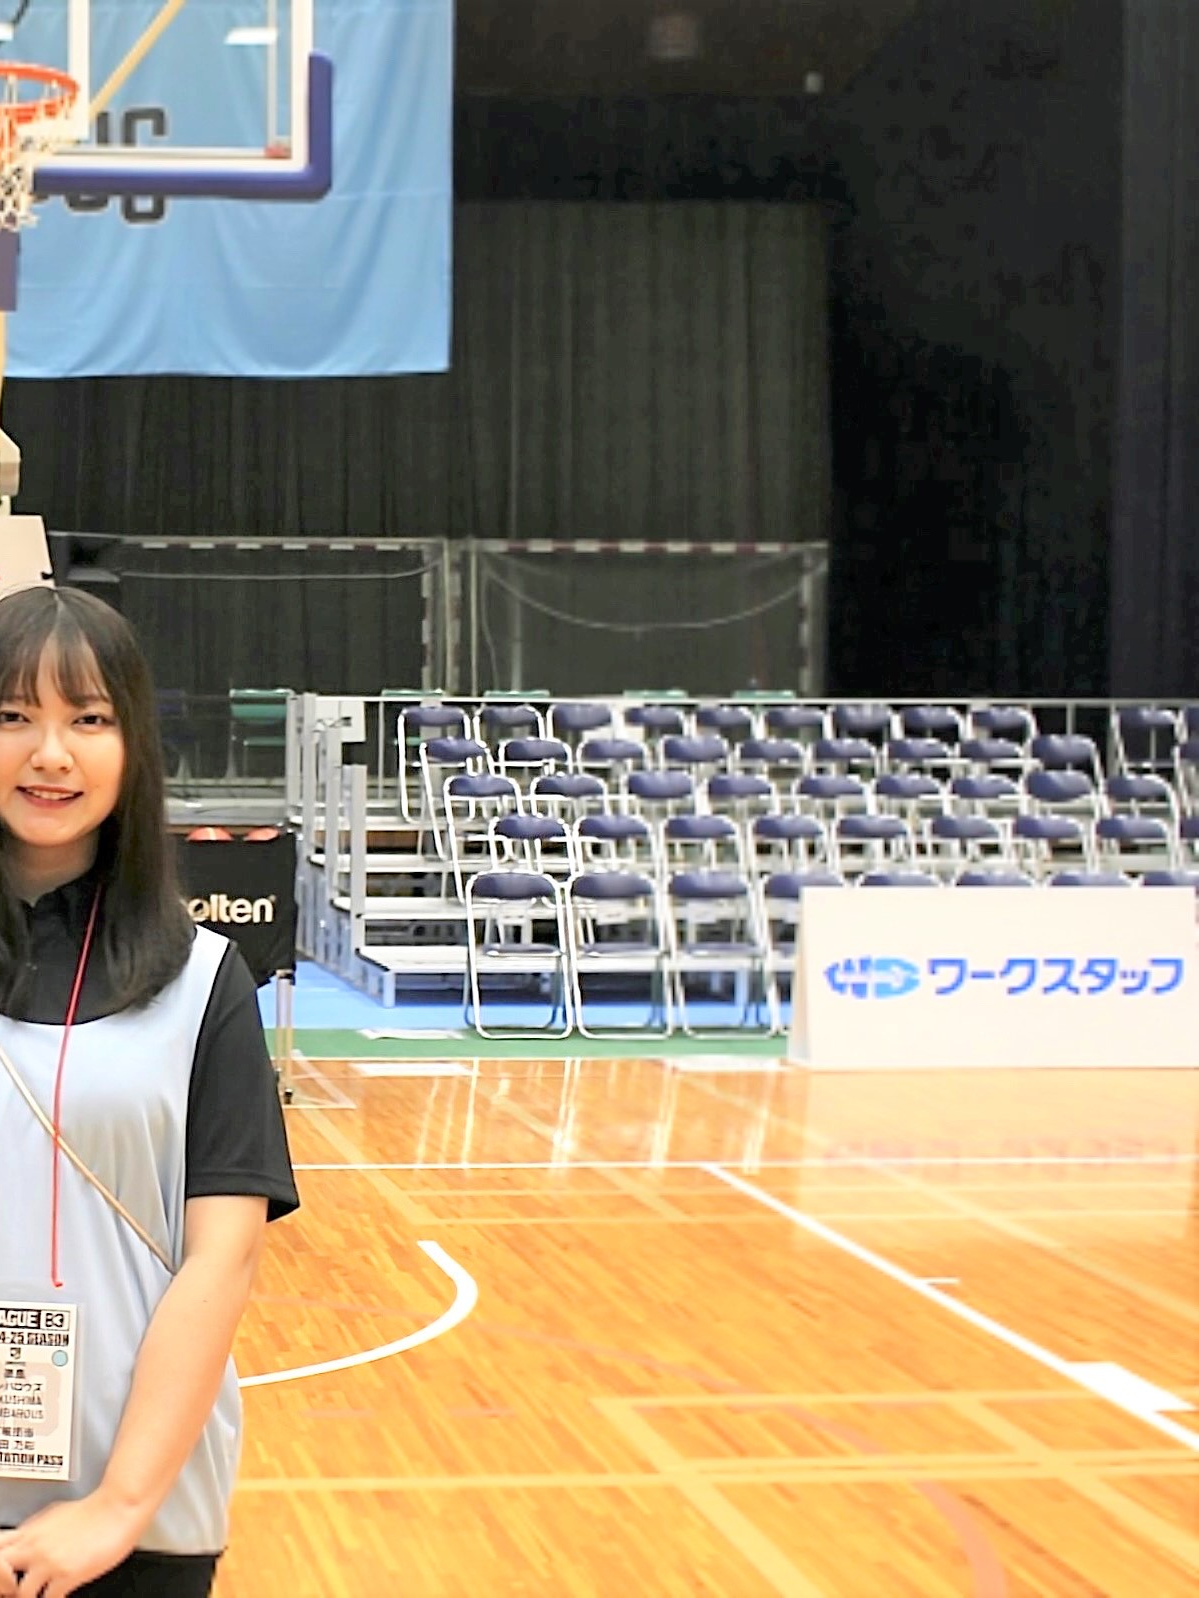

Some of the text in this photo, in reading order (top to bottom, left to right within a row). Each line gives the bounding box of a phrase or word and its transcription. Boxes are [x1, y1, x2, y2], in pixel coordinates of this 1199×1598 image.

[188, 894, 274, 923] olten
[928, 958, 1184, 995] ワークスタッフ
[45, 1312, 64, 1328] B3
[37, 1455, 63, 1466] PASS
